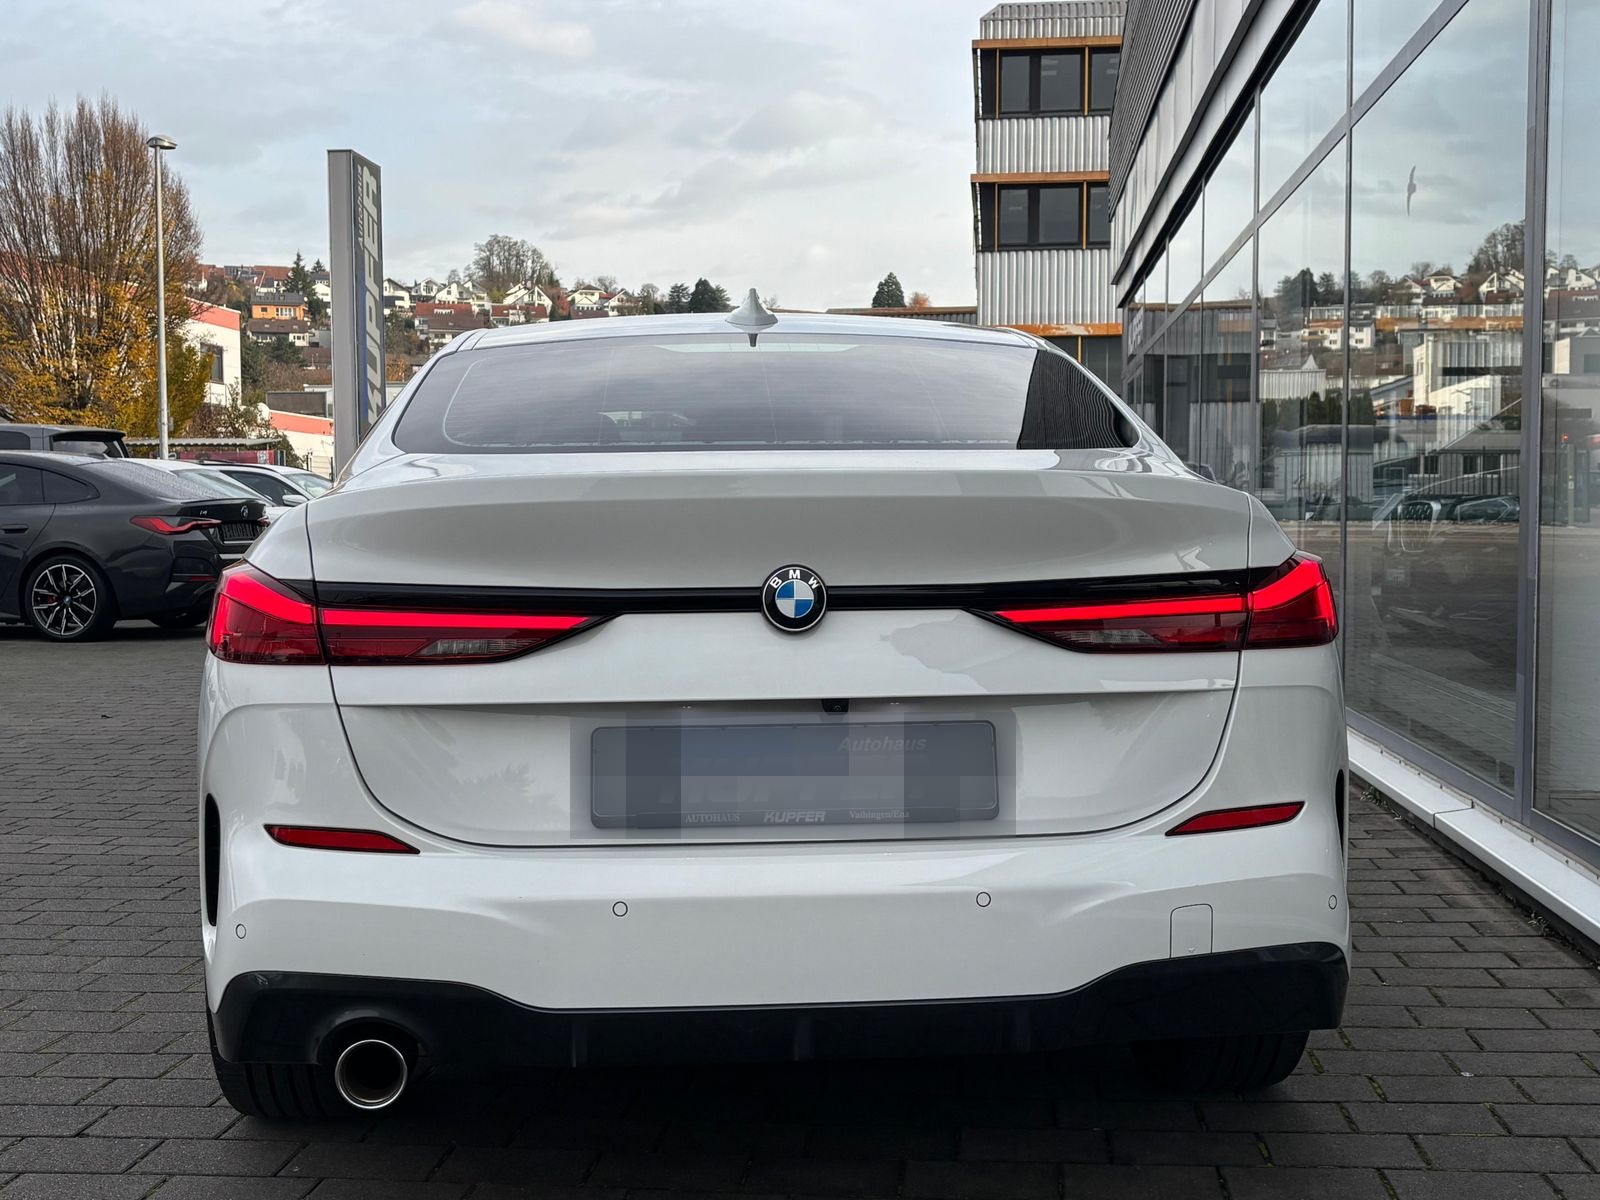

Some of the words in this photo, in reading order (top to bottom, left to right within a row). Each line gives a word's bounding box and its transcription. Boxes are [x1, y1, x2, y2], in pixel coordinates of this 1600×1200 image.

[361, 166, 381, 425] KUPFER
[770, 569, 820, 589] BMW
[837, 735, 927, 753] Autohaus
[684, 812, 740, 824] AUTOHAUS
[763, 810, 826, 824] KUPFER
[848, 809, 910, 821] Vaihingen/Enz
